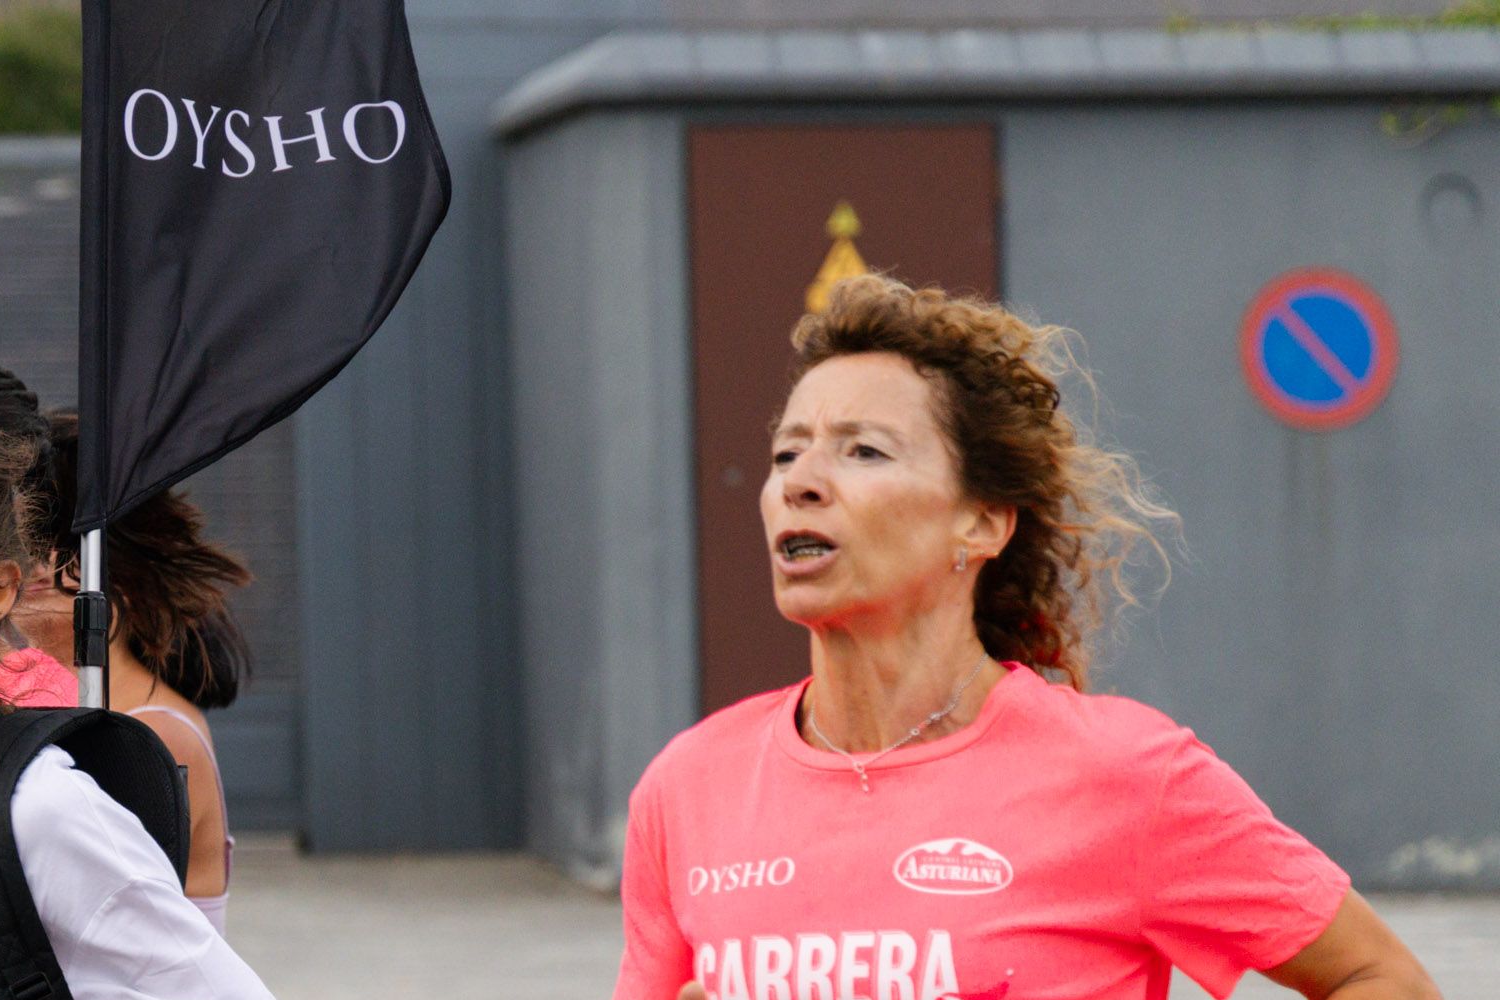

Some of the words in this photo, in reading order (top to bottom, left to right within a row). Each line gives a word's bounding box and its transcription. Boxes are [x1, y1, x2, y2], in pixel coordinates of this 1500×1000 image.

[124, 88, 406, 178] OYSHO
[688, 857, 796, 896] OYSHO
[902, 855, 1002, 886] ASTURIANA
